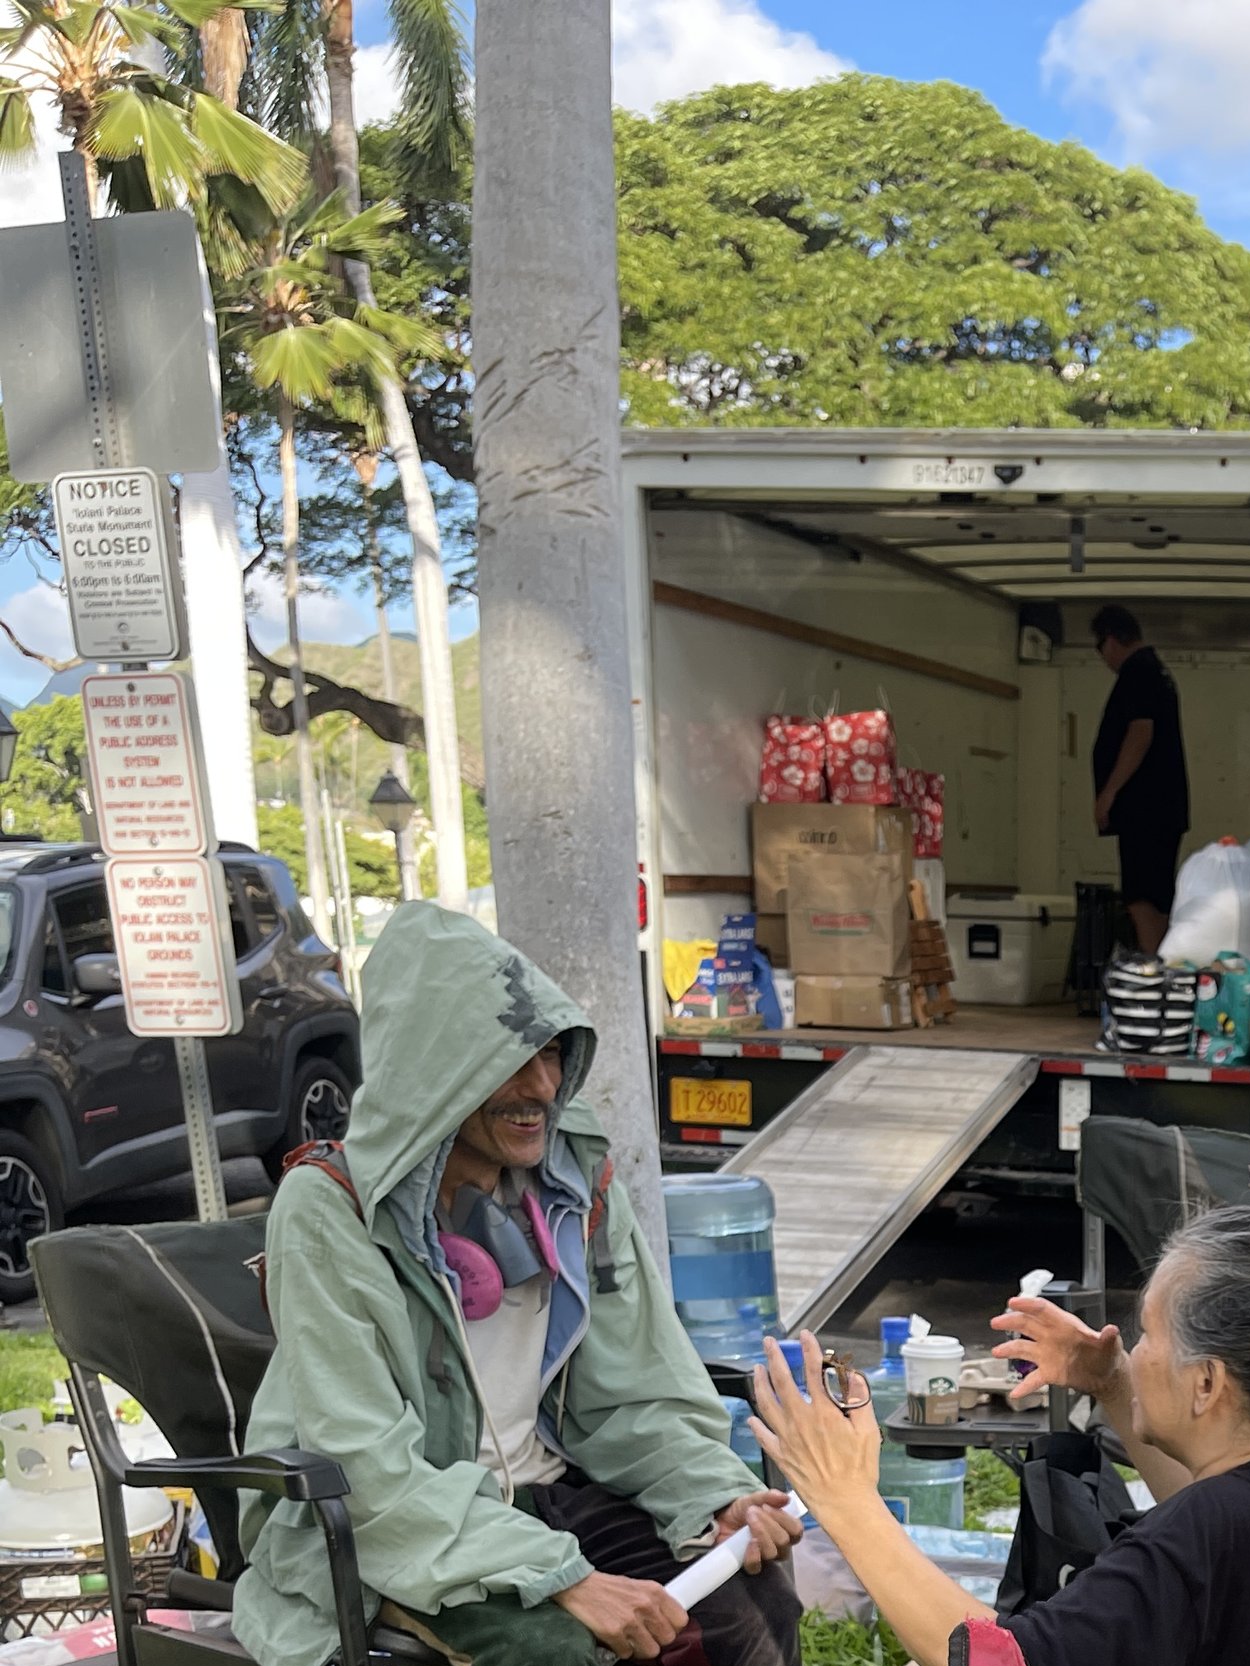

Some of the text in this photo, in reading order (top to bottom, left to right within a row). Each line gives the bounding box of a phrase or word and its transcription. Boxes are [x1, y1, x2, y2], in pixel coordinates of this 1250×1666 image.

[69, 478, 142, 500] NOTICE
[106, 505, 143, 517] Palace
[98, 519, 152, 533] Monument
[73, 536, 151, 557] CLOSED
[128, 695, 141, 707] BY
[143, 693, 177, 706] PERMIT
[103, 716, 121, 728] THE
[125, 715, 143, 727] USE
[146, 714, 159, 727] OF
[100, 734, 179, 749] PUBLIC ADDRESS
[123, 755, 161, 768] SYSTEM
[118, 776, 137, 788] NOT
[140, 775, 184, 787] ALLOWED
[138, 877, 175, 889] PERSON
[137, 895, 187, 907] OBSTRUCT
[121, 912, 209, 925] PUBLIC ACCESS TO
[147, 950, 193, 962] GROUNDS
